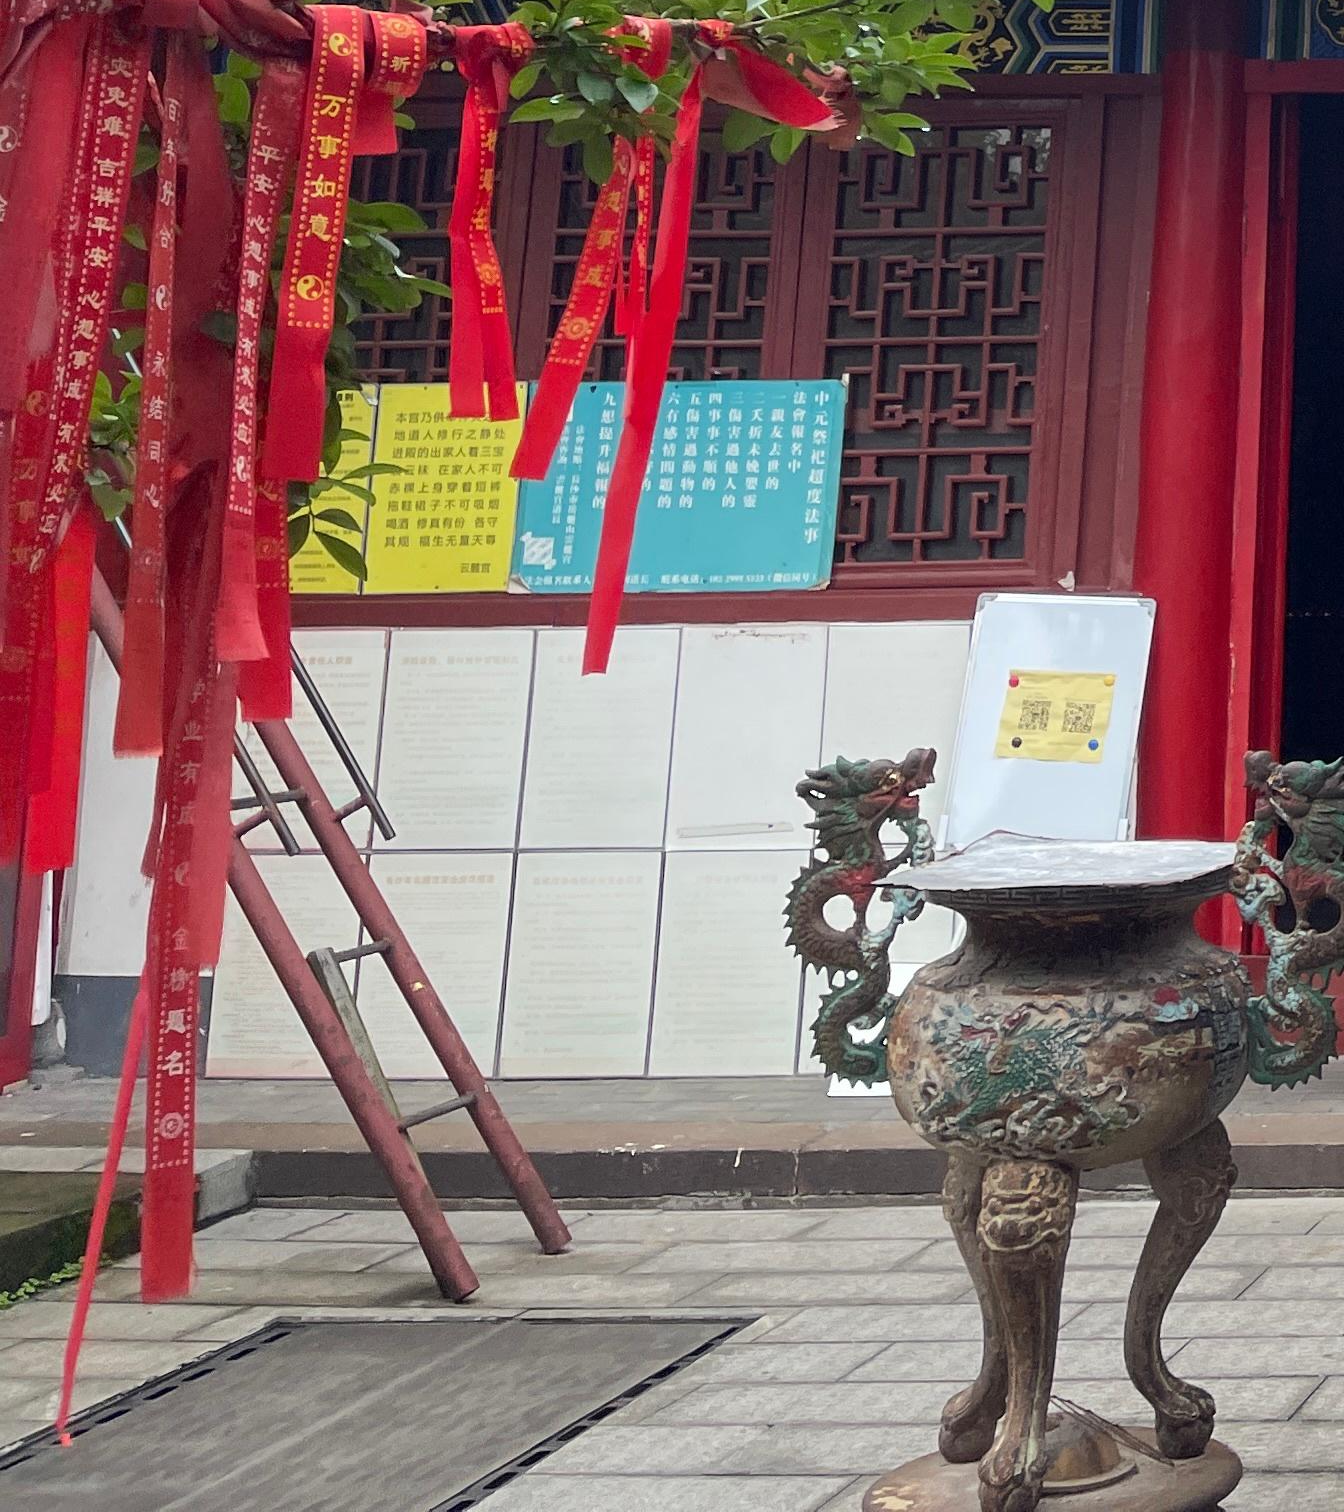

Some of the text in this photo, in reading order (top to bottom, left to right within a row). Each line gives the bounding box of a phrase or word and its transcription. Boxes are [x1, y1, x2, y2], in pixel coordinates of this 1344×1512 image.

[88, 158, 121, 268] 吉祥平安
[306, 94, 347, 242] 万事如意
[66, 290, 101, 399] 心想事成
[804, 390, 830, 544] 中元祭祀超度法事
[162, 928, 190, 1077] 金榜题名
